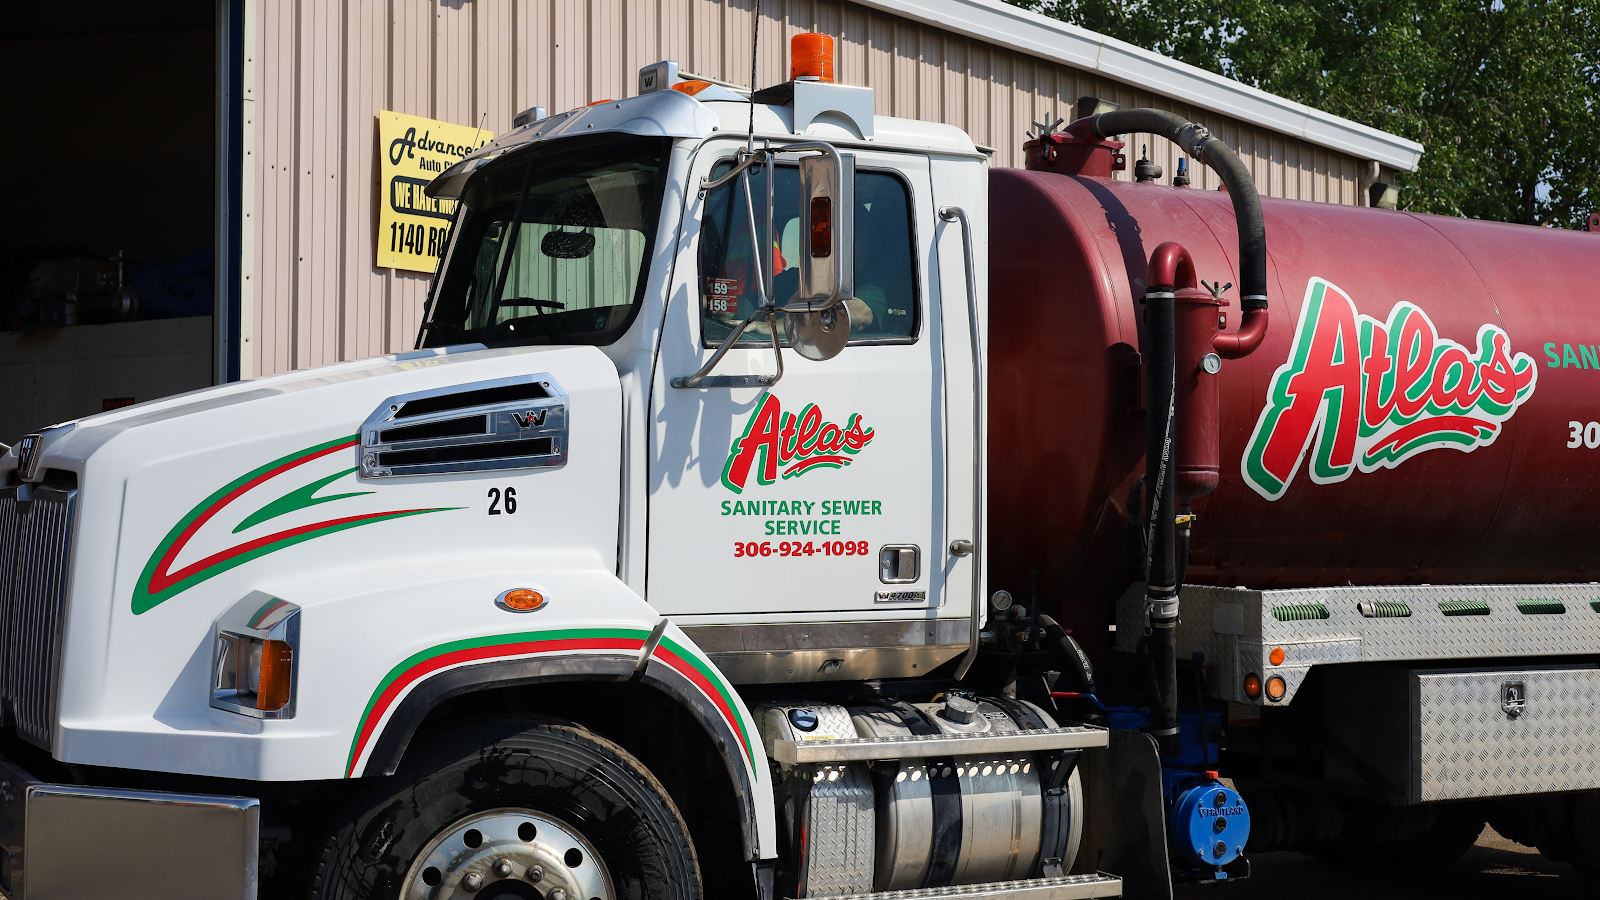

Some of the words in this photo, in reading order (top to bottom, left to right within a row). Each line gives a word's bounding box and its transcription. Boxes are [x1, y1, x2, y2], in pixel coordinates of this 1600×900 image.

[419, 157, 441, 173] Auto
[394, 180, 412, 209] WE
[412, 183, 438, 213] HAVE
[390, 221, 425, 256] 1140
[708, 282, 728, 295] 159
[708, 299, 728, 312] 158
[1543, 342, 1600, 370] SAN
[1245, 280, 1534, 497] Atlas
[721, 391, 875, 495] Atlas
[1566, 420, 1600, 450] 30
[487, 486, 517, 516] 26
[721, 500, 815, 516] SANITARY
[821, 500, 882, 516] SEWER
[764, 520, 841, 536] SERVICE
[734, 540, 869, 557] 306-924-1098
[1206, 806, 1244, 817] FRUITLAND
